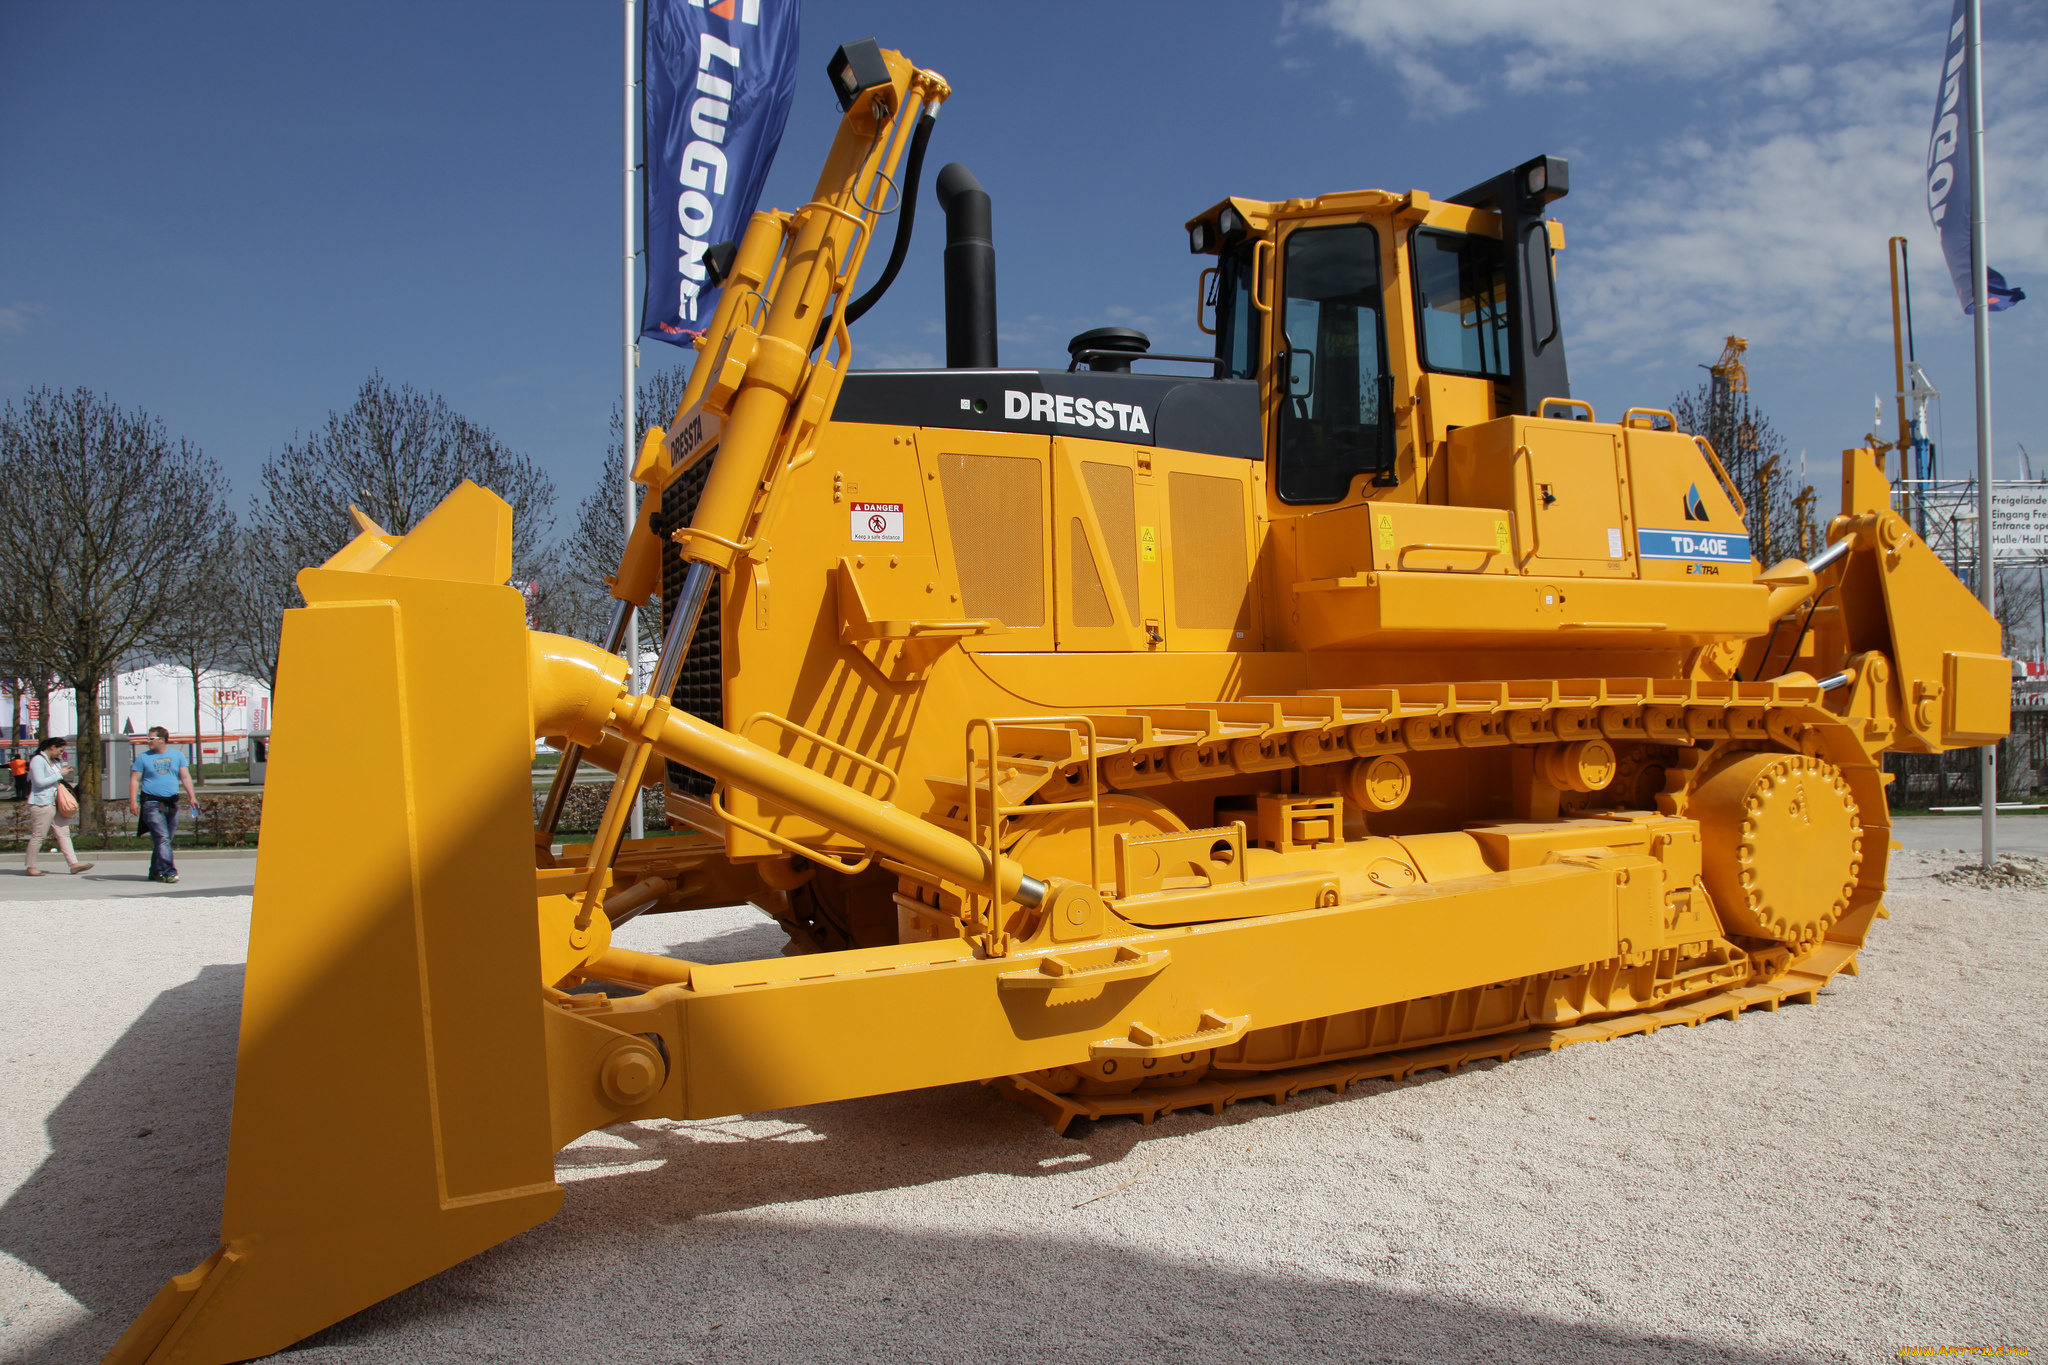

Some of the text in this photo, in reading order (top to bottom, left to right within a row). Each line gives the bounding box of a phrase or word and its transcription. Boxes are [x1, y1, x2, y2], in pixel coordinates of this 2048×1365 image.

[1004, 390, 1151, 434] DRESSTA
[671, 414, 702, 467] DRESSTA
[1991, 495, 2048, 506] Freigelände
[864, 504, 900, 512] DANGER
[1992, 510, 2030, 520] Eingang
[1992, 521, 2030, 530] Entrance
[1992, 534, 2041, 544] Halle/Hall
[1671, 536, 1728, 556] TD-40E
[1686, 563, 1720, 575] EXTRA
